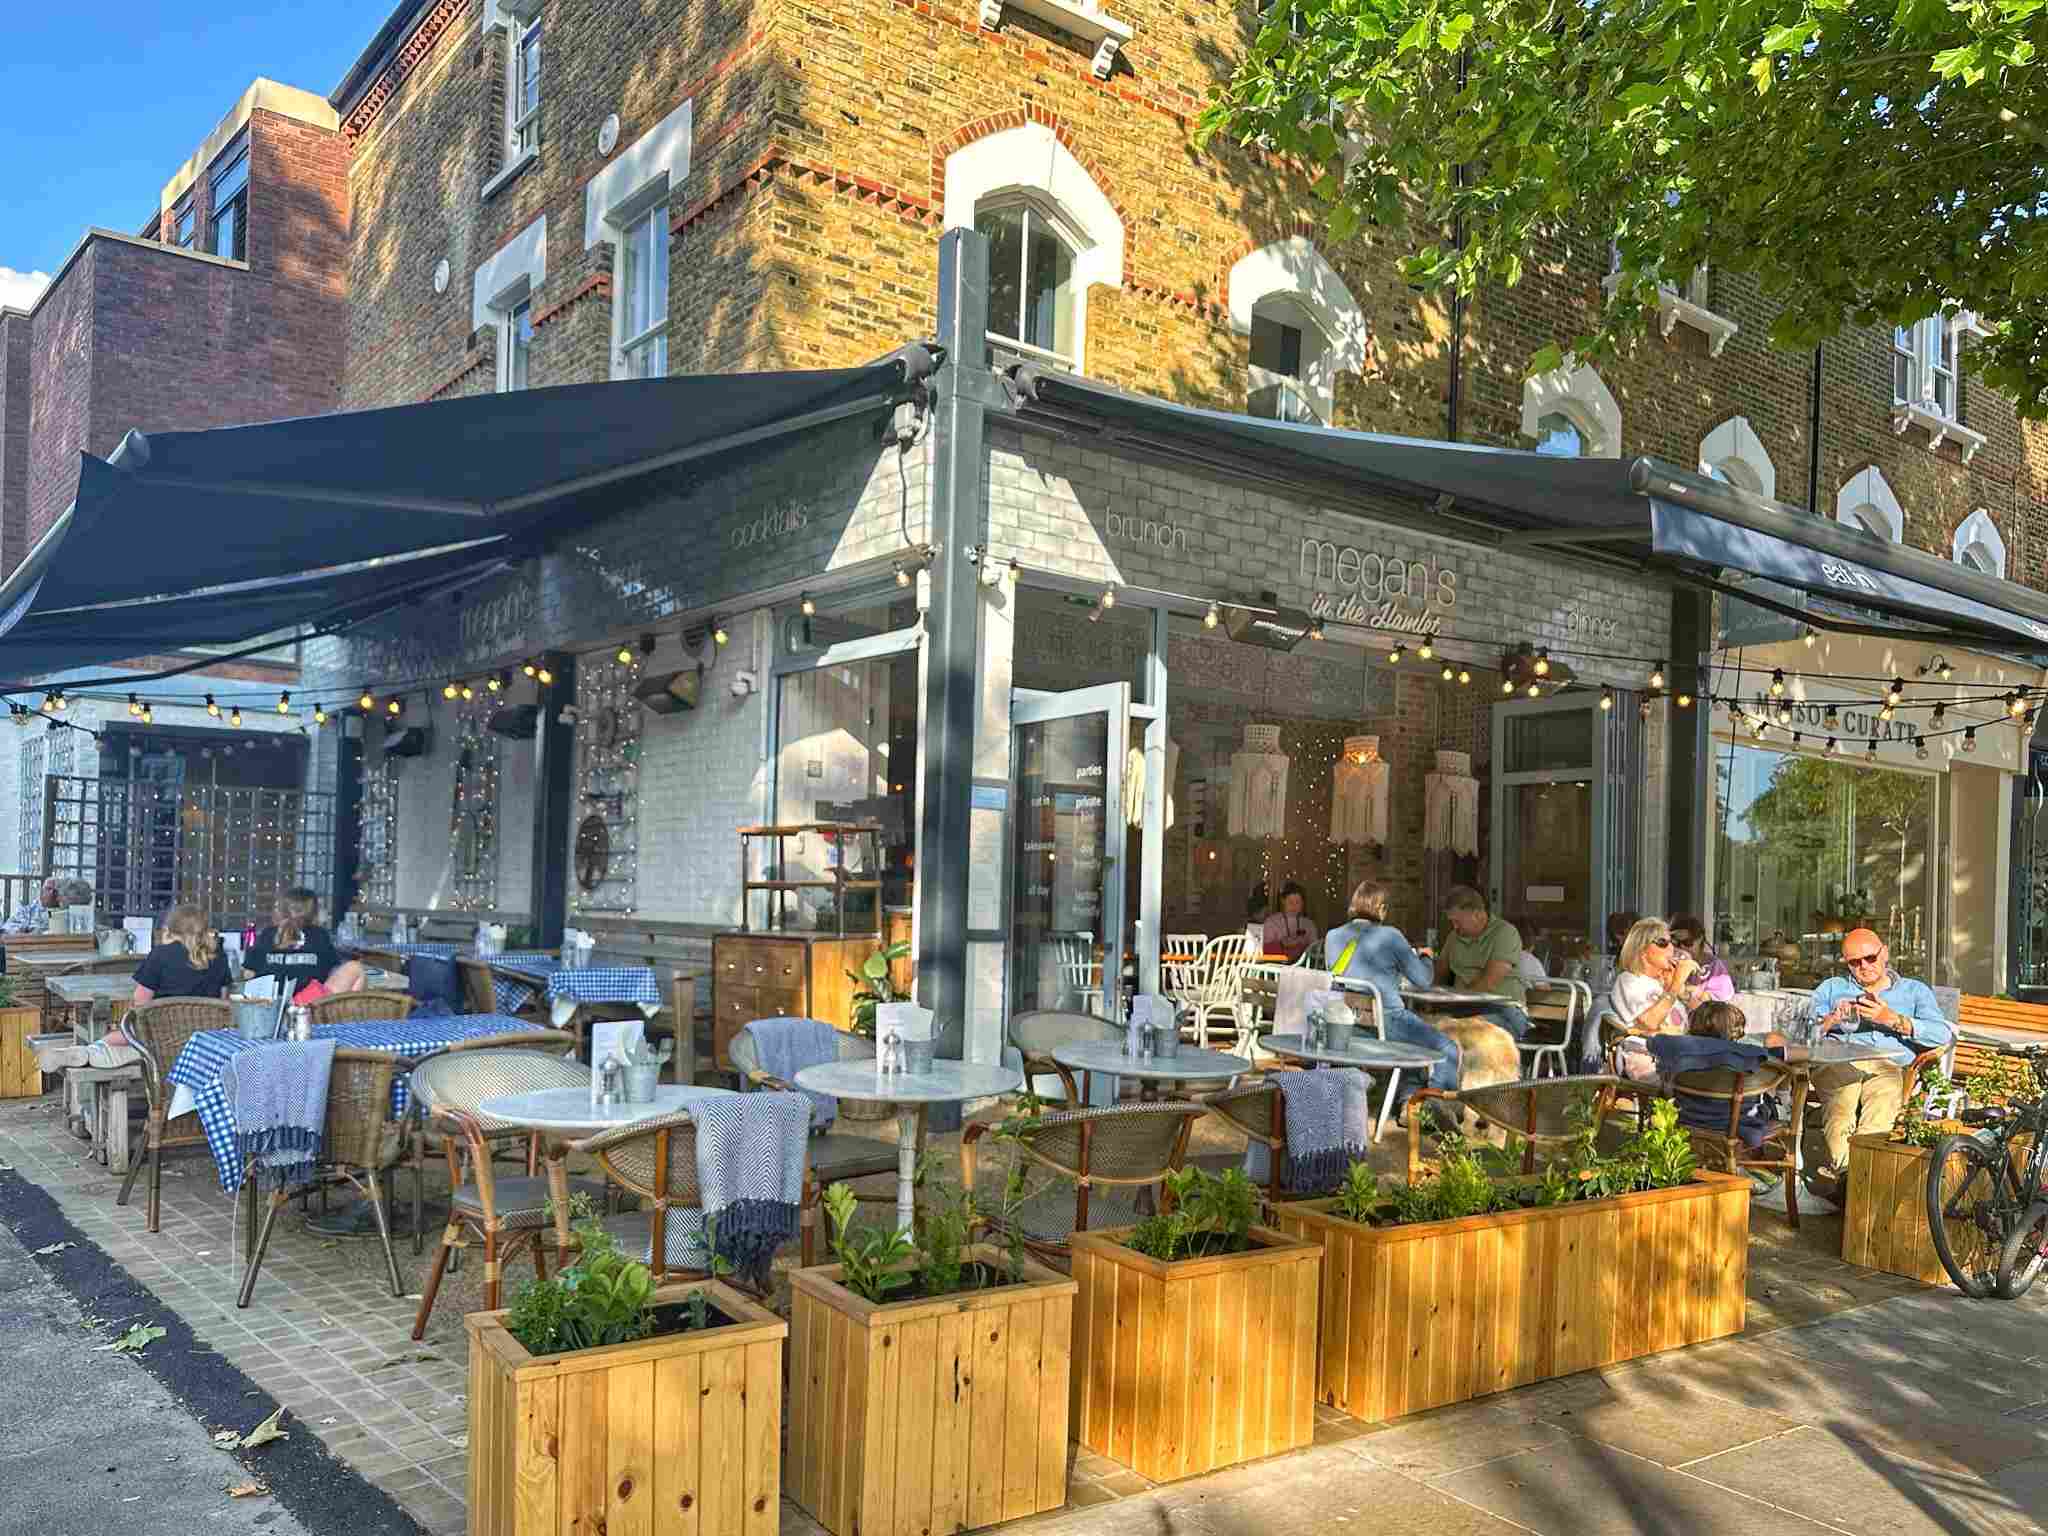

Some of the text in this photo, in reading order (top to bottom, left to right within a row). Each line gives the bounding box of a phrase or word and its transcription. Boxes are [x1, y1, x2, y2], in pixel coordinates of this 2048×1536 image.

[1106, 506, 1186, 553] brunch
[1301, 537, 1457, 607] megan's
[1821, 563, 1878, 590] eat in
[1311, 592, 1441, 636] in the Hamlet
[1568, 606, 1618, 641] dinner
[1843, 710, 1919, 745] CURATE
